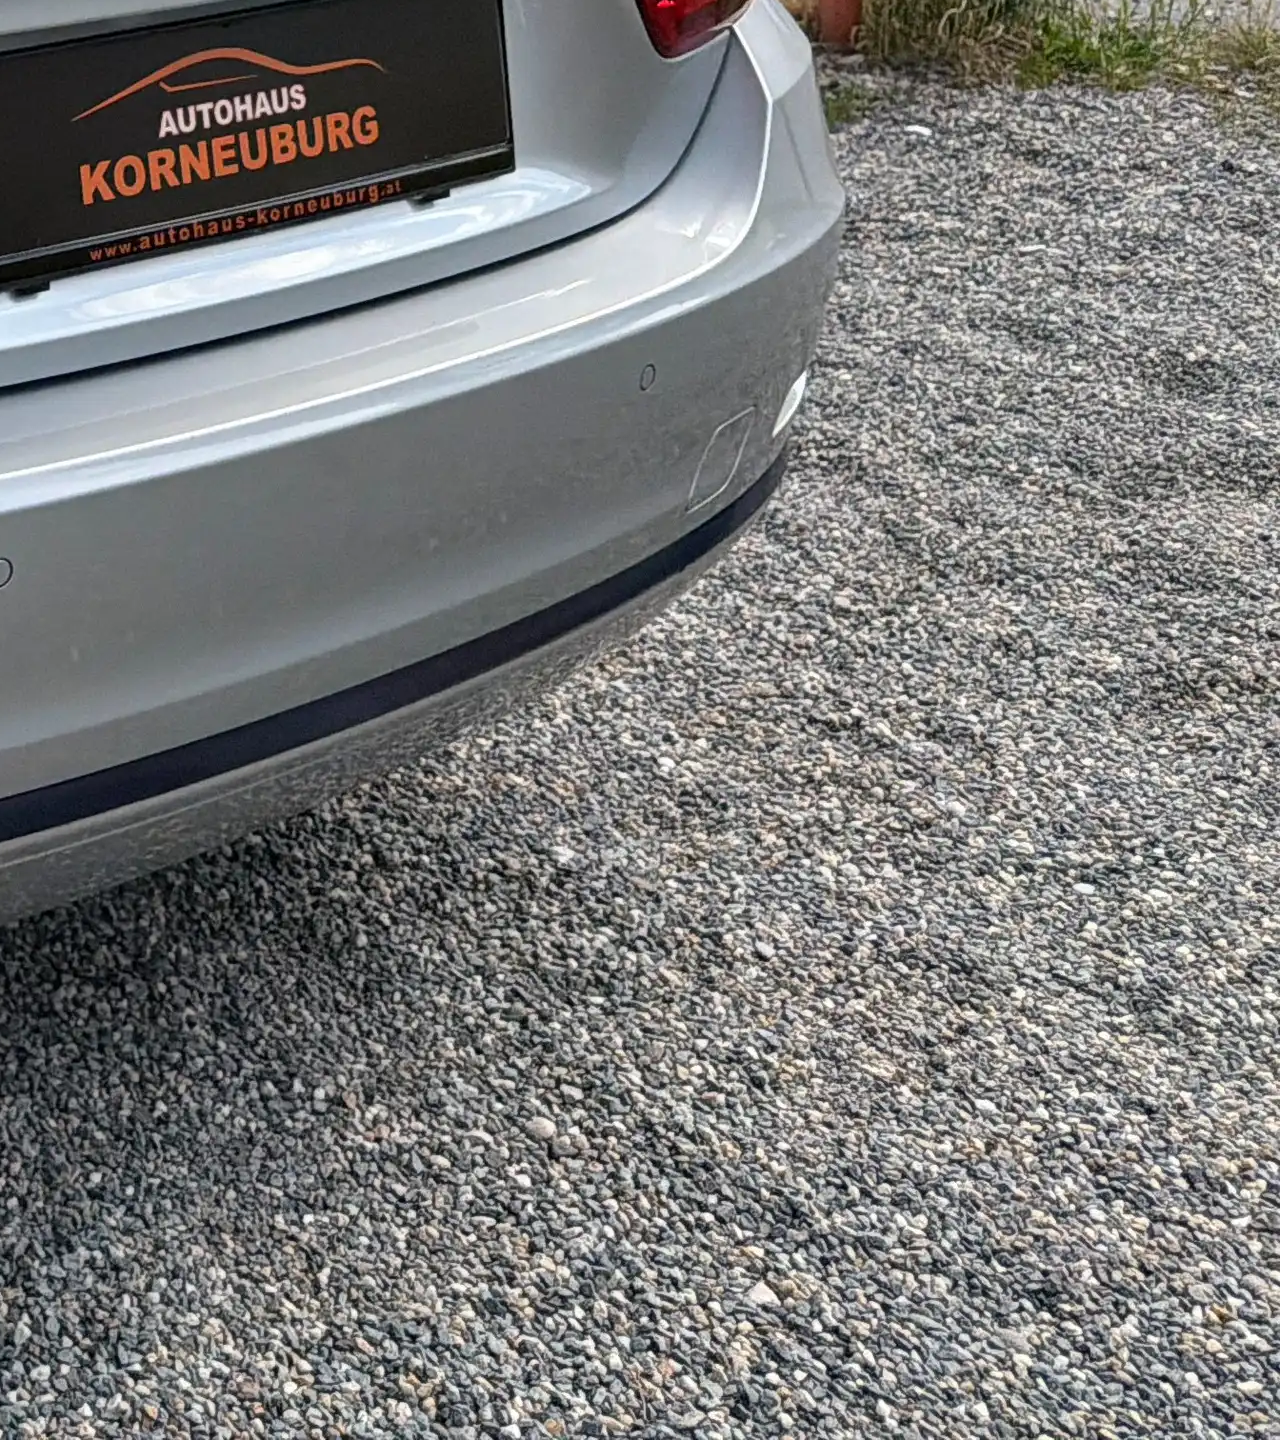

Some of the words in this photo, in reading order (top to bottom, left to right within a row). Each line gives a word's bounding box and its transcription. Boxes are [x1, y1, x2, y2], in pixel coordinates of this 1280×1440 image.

[157, 82, 307, 139] AUTOHAUS
[78, 105, 381, 207] KORNEUBURG
[88, 179, 404, 263] www.autohaus-korneuburg.at
